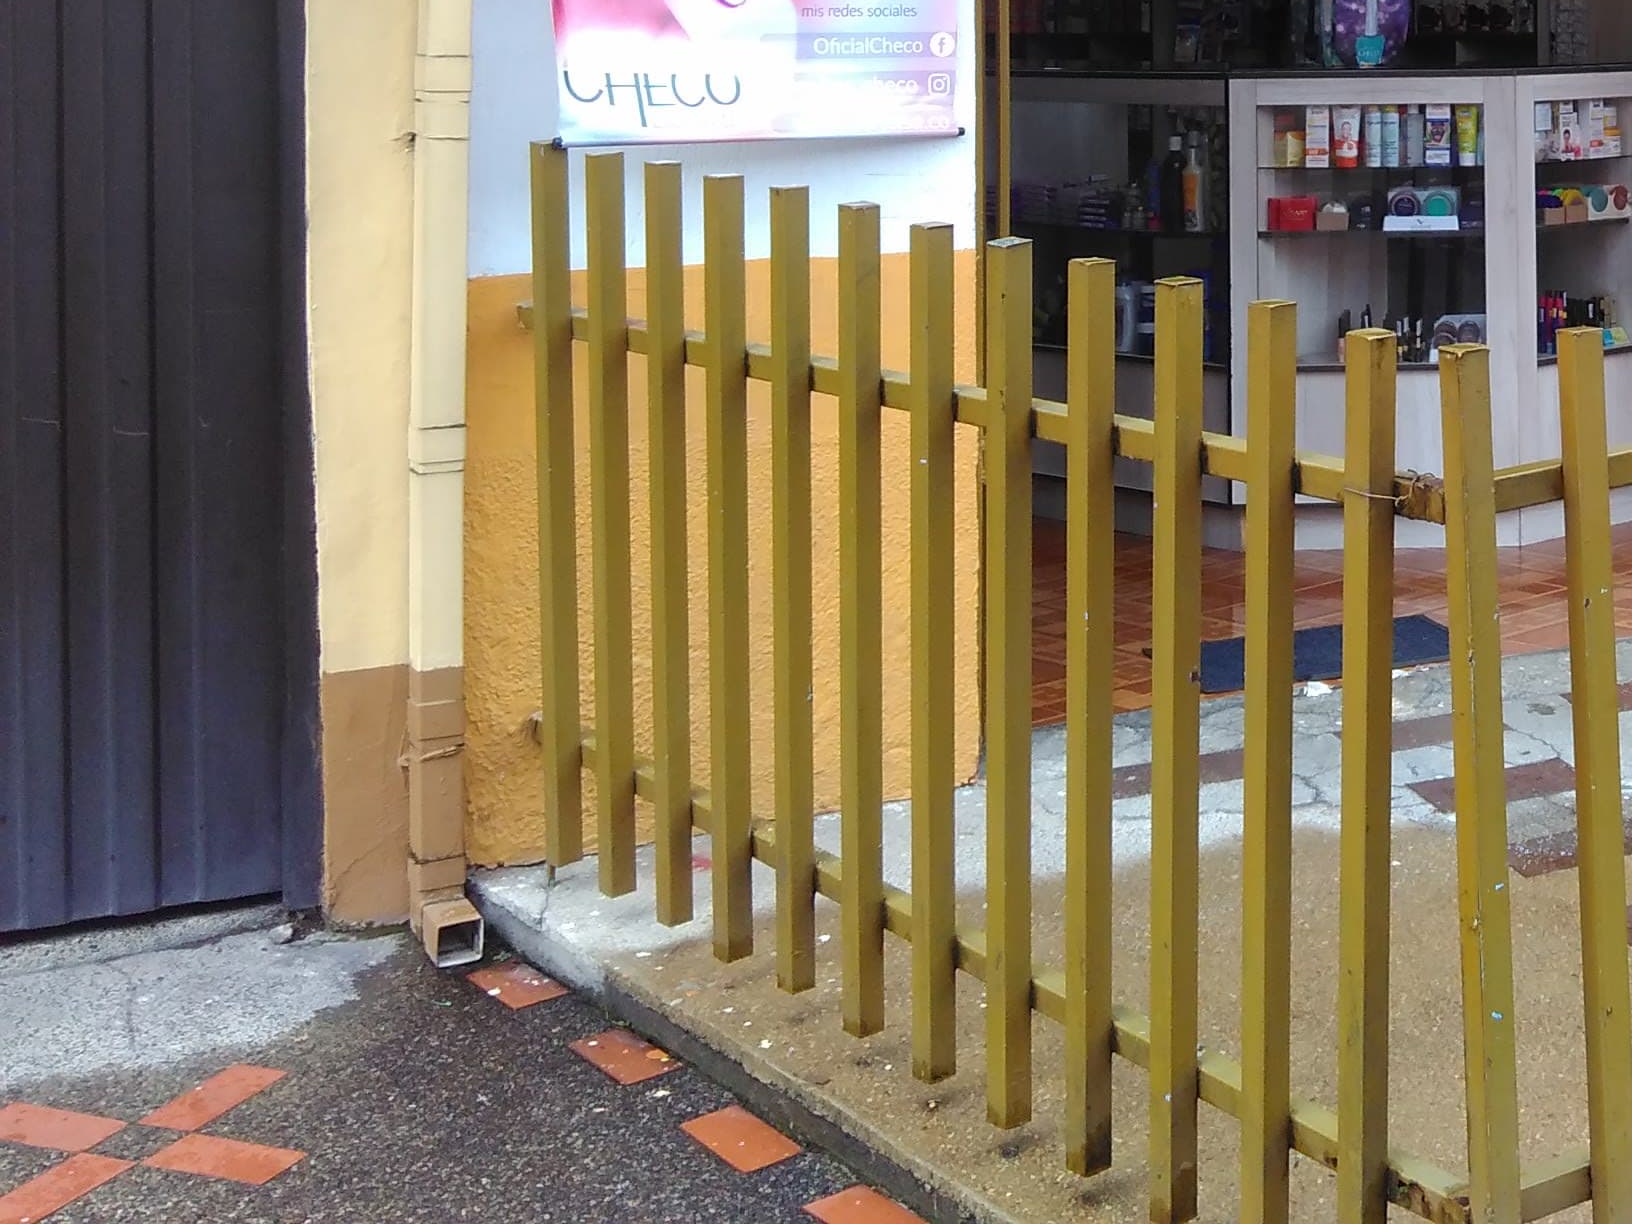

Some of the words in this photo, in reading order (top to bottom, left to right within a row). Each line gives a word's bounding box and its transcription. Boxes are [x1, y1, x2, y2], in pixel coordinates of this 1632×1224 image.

[801, 5, 824, 17] mis
[828, 4, 863, 17] redes
[867, 4, 917, 17] sociales
[813, 37, 924, 55] OficialCheco
